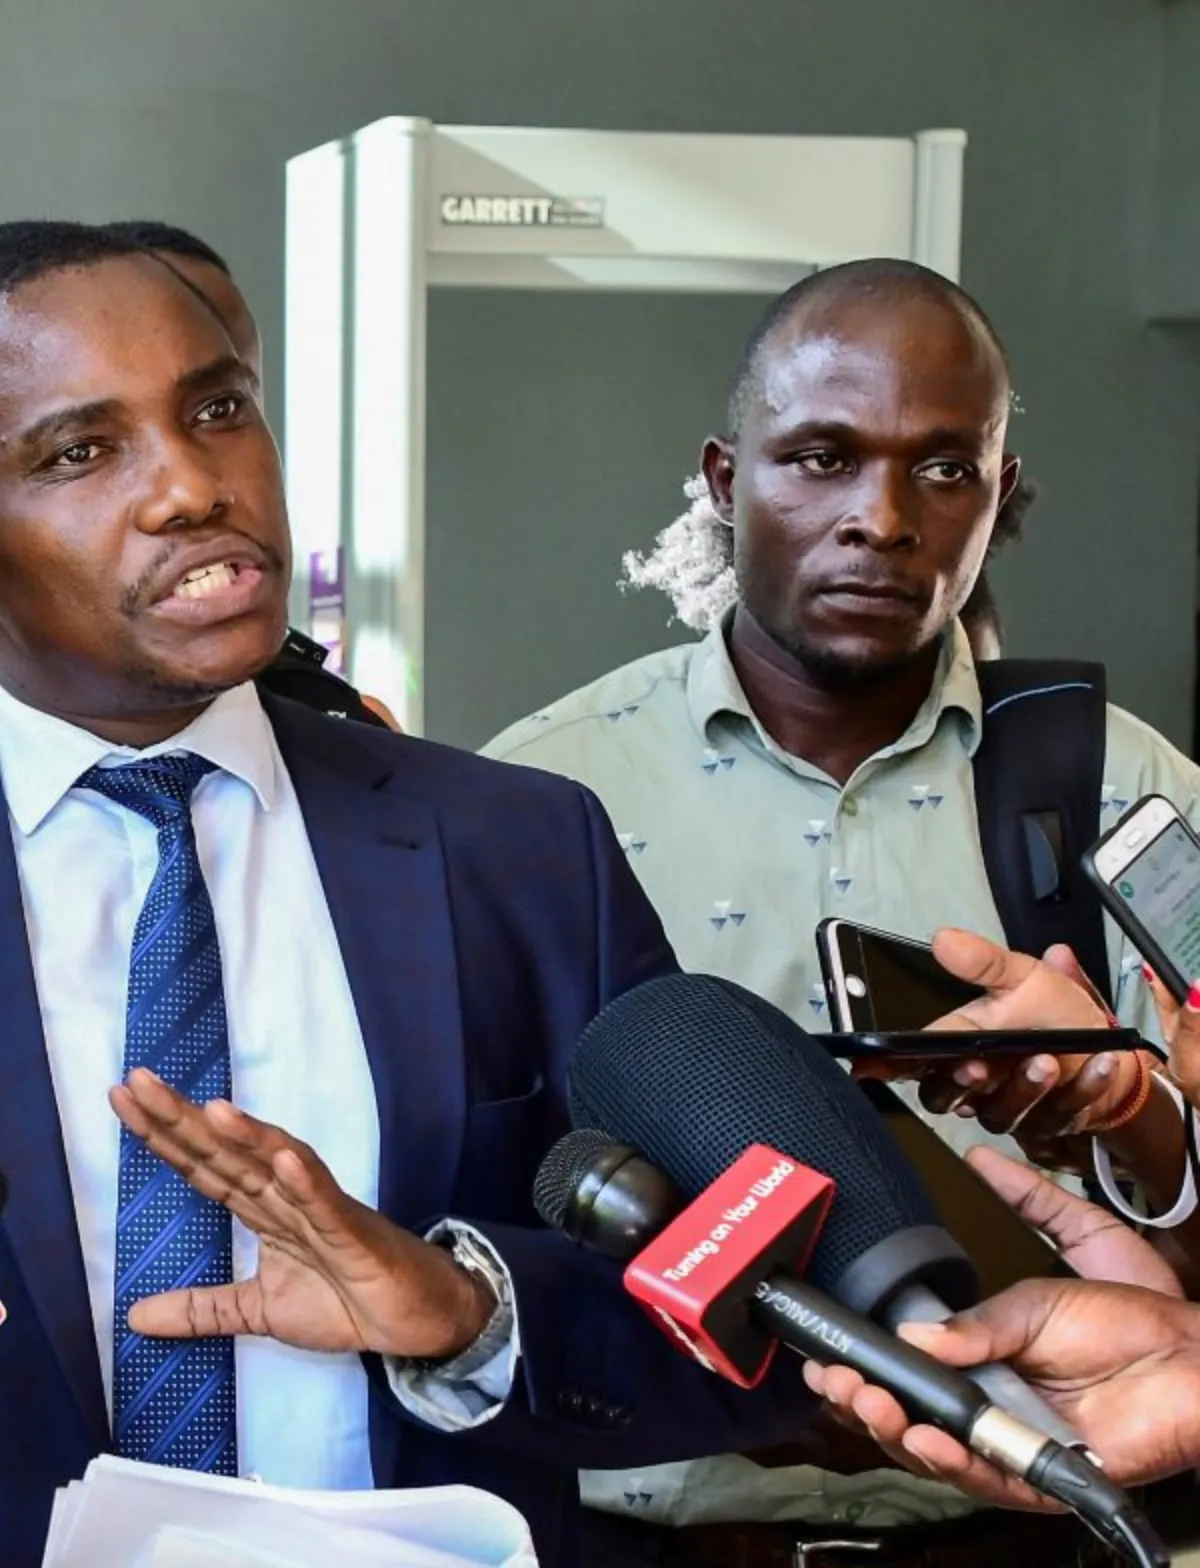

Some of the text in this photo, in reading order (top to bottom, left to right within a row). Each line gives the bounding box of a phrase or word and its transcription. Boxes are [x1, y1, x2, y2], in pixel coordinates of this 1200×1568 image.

[441, 197, 552, 224] GARRETT
[662, 1160, 795, 1282] Turning on Your World
